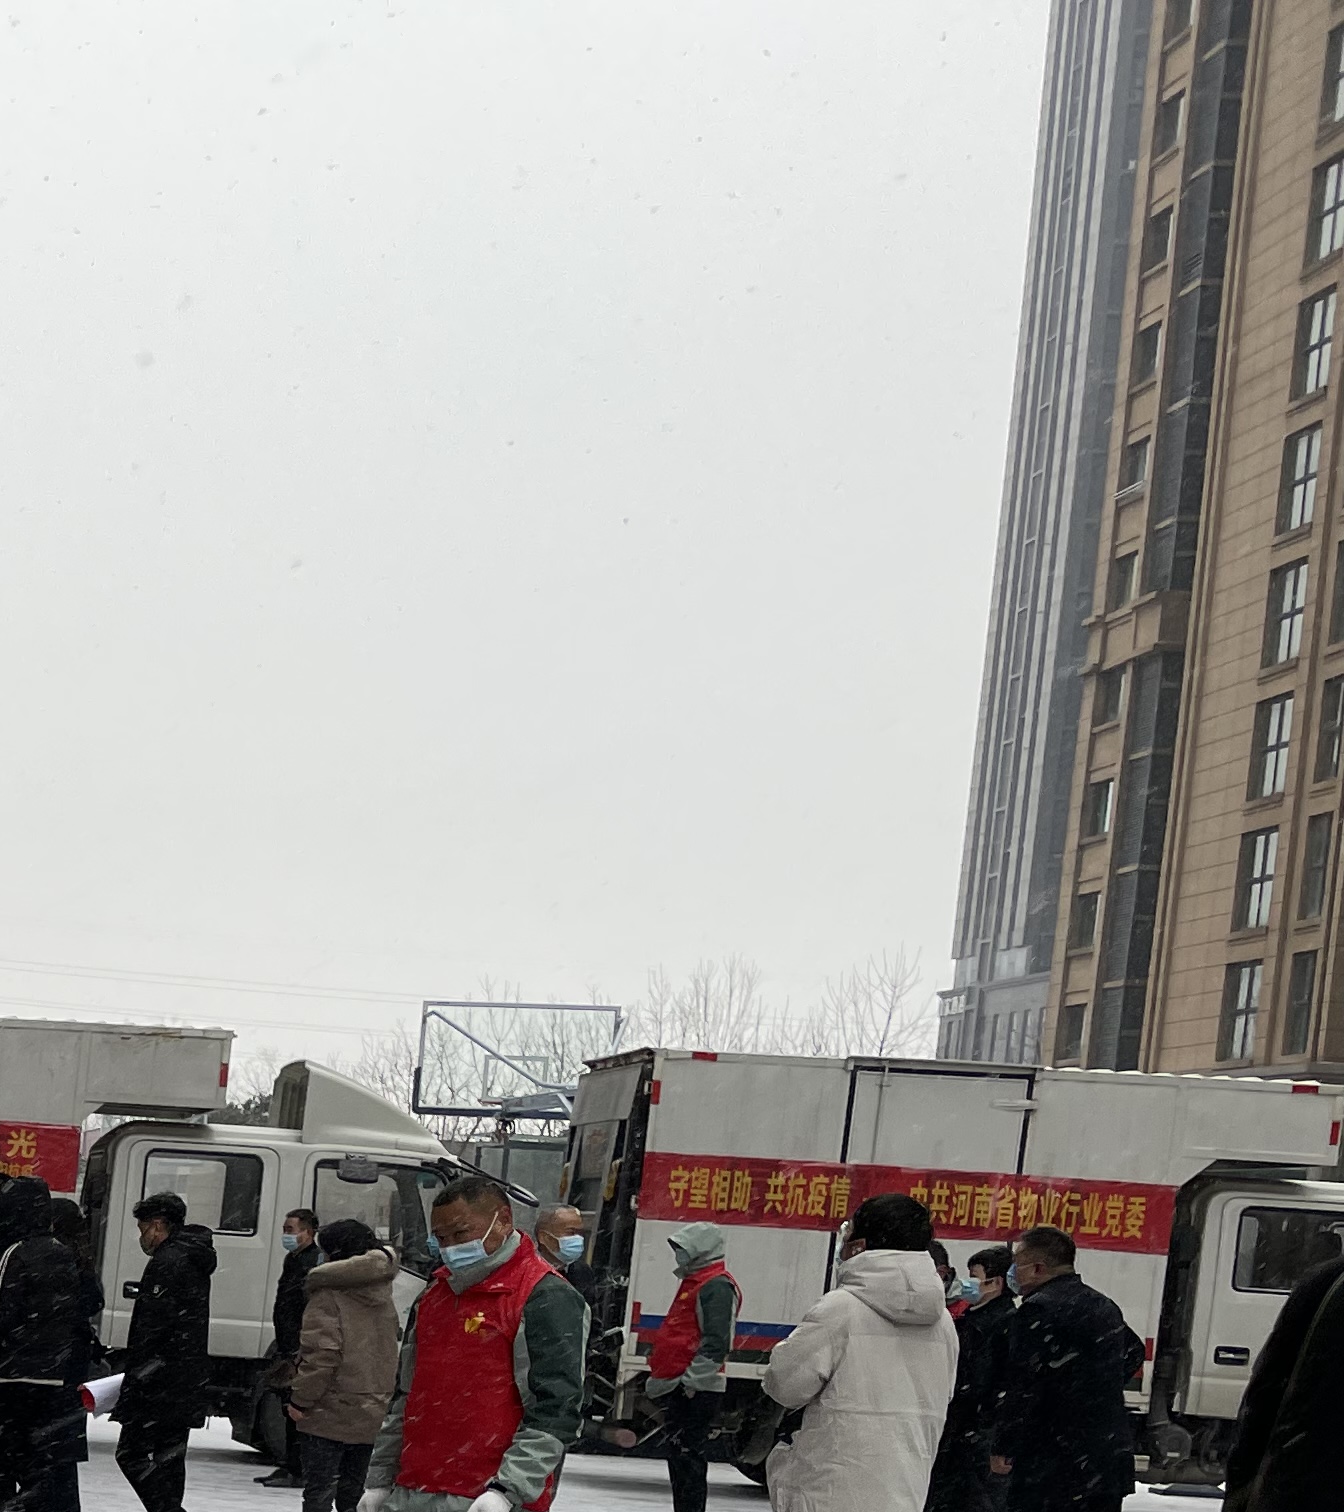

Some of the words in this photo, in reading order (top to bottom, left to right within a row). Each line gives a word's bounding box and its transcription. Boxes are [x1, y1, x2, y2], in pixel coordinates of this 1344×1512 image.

[668, 1164, 752, 1214] 守望相助
[764, 1172, 851, 1219] 共抗疫情
